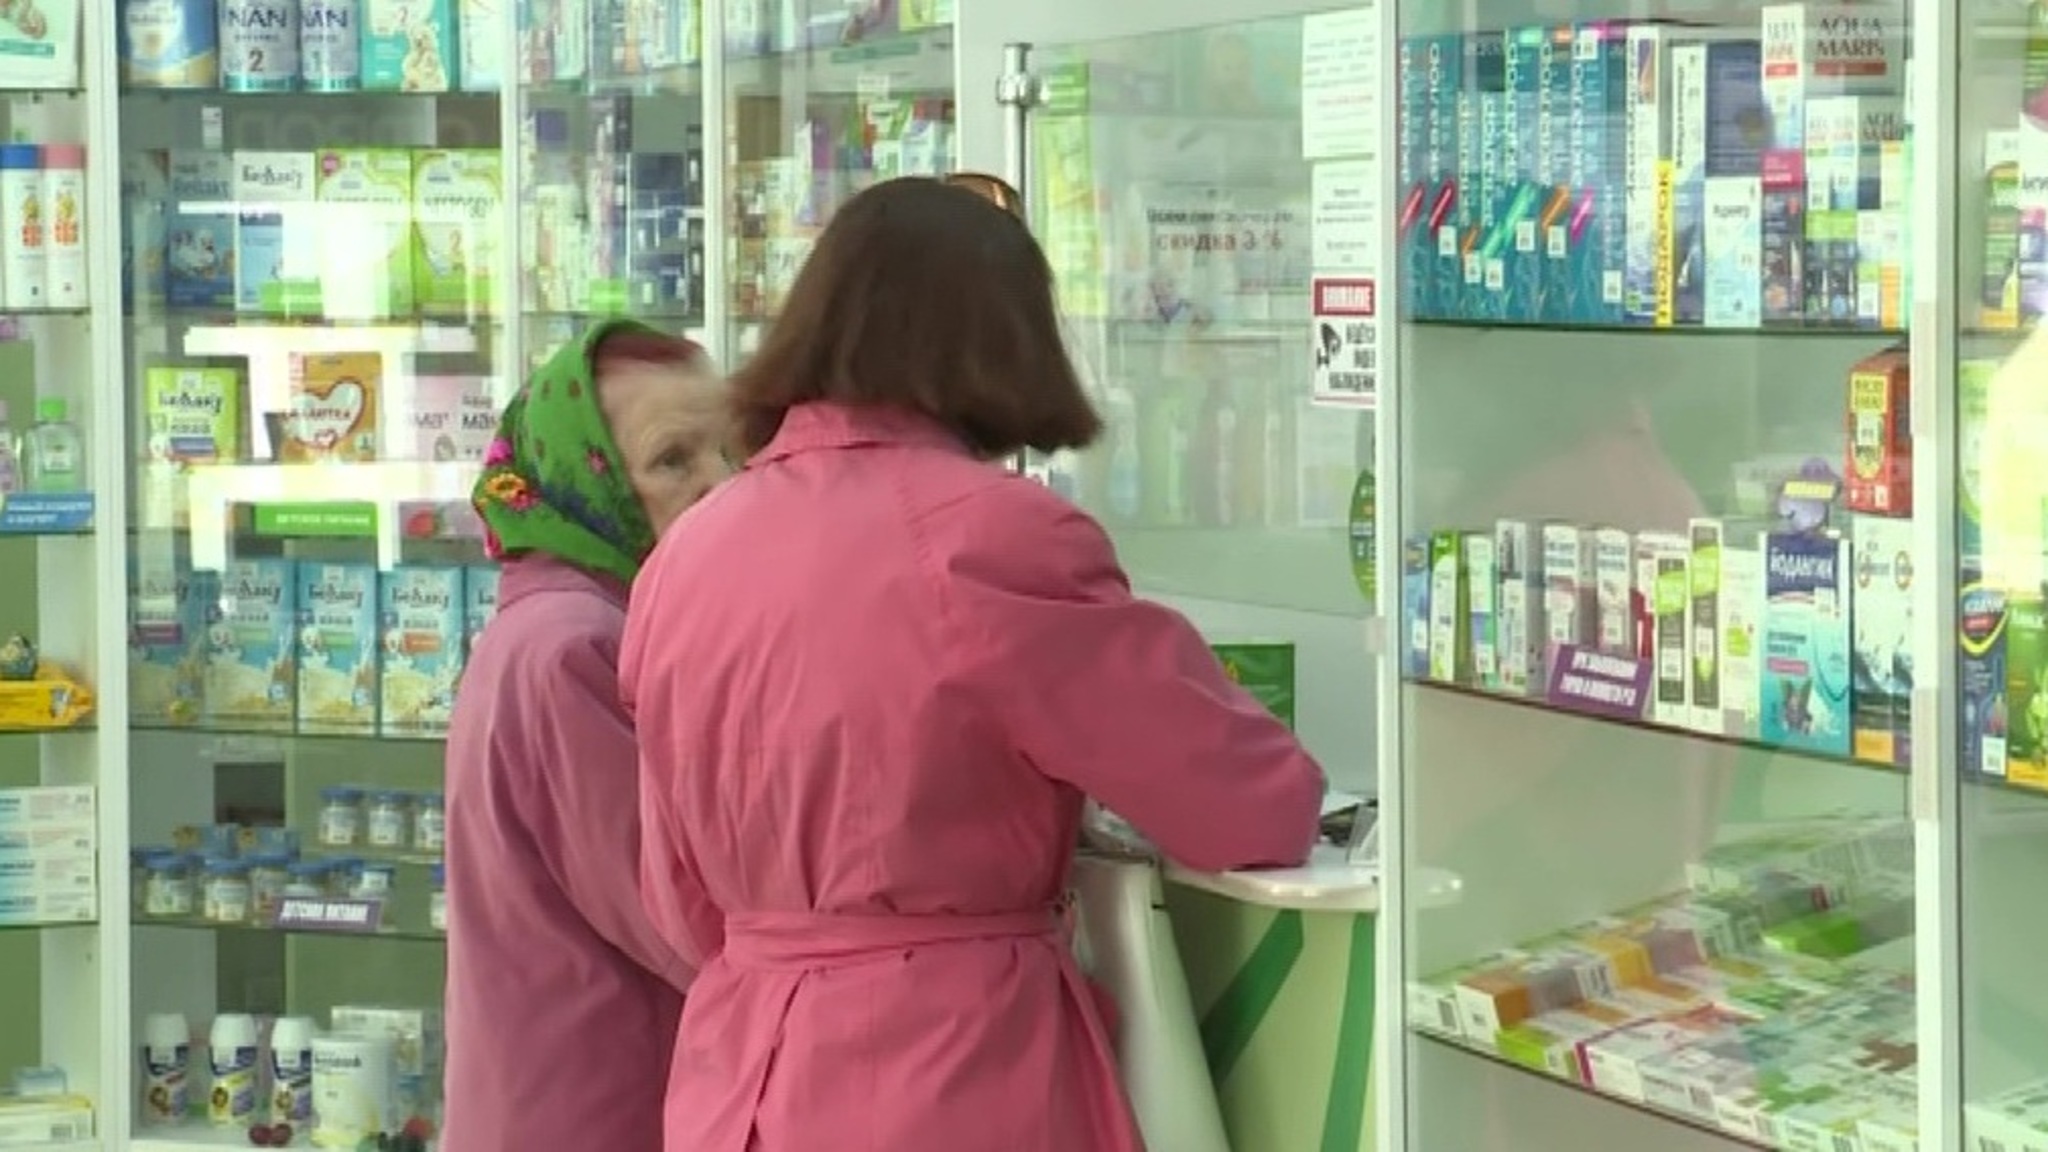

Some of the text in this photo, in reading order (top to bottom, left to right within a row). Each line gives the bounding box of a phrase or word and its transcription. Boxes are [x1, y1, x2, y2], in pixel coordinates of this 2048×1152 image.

[226, 8, 288, 28] NAN
[1819, 16, 1883, 34] AQUA
[1816, 38, 1886, 57] MARIS
[248, 49, 264, 73] 2
[1155, 233, 1237, 254] скидка
[1242, 230, 1257, 251] 3
[1657, 170, 1673, 321] ПОДАРОК
